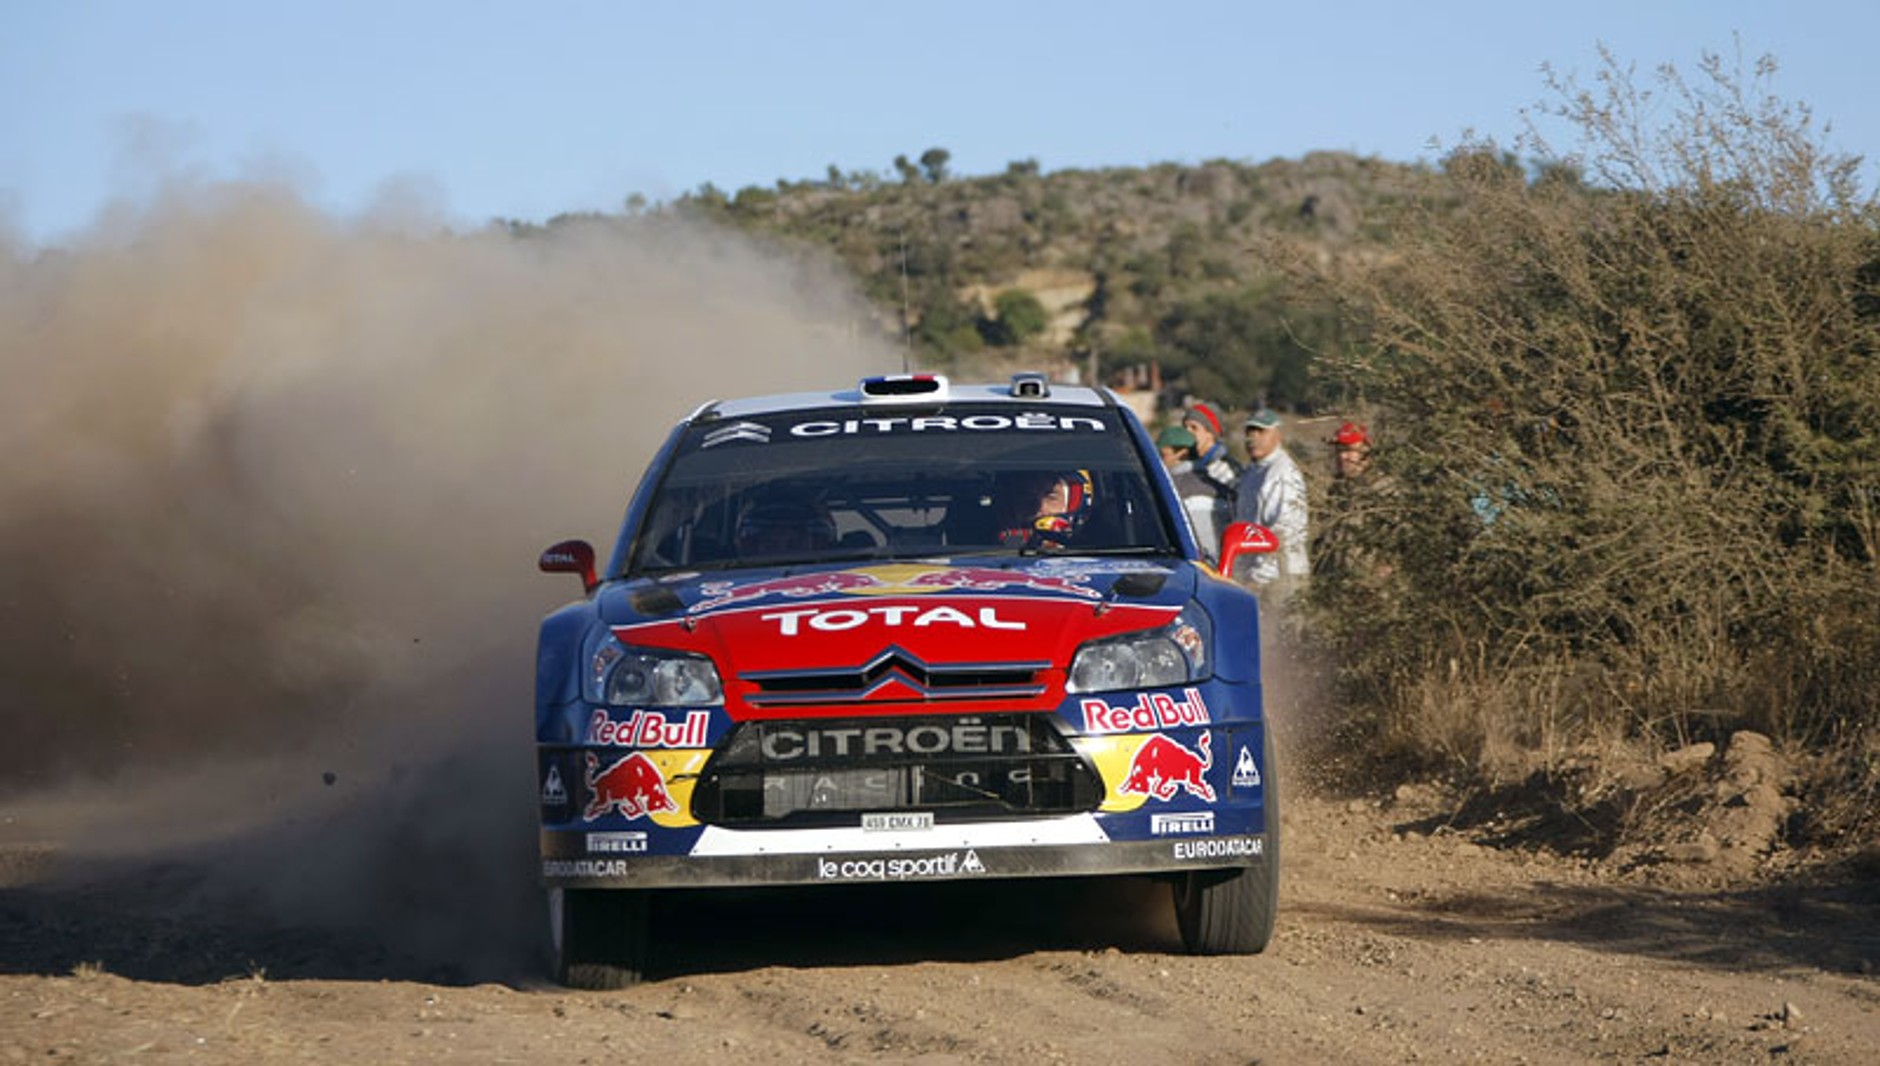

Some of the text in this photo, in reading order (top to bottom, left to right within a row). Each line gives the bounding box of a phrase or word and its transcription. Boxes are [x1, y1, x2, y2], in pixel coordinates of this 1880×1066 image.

[789, 412, 1106, 436] CITROËN
[761, 606, 1027, 636] TOTAL
[1081, 688, 1211, 734] Red Bull
[584, 710, 710, 748] Red Bull
[762, 717, 1031, 760] CITROËN
[1151, 811, 1215, 835] PIRELLI
[586, 831, 648, 852] PIRELLI
[1174, 838, 1262, 859] EURODATACAR
[818, 852, 958, 881] le coq sportif
